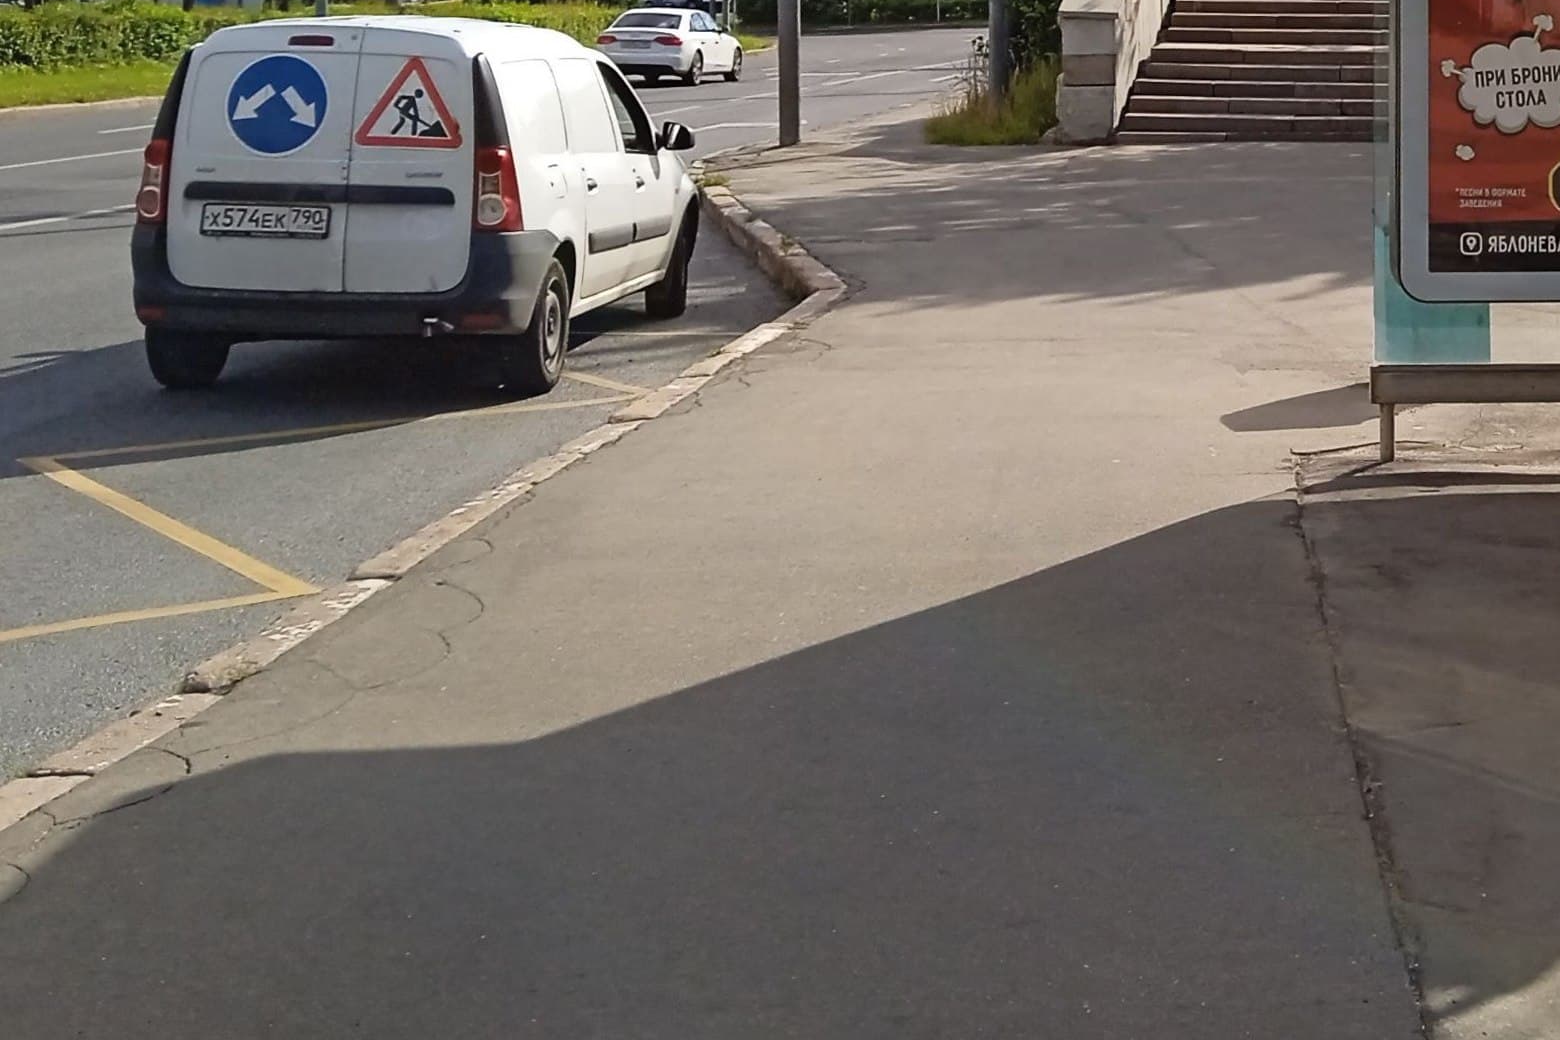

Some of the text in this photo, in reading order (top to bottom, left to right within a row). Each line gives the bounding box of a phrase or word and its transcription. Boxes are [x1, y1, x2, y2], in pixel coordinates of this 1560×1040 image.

[1474, 69, 1506, 88] ПРИ
[1495, 90, 1548, 109] СТОЛА
[292, 209, 323, 225] 790
